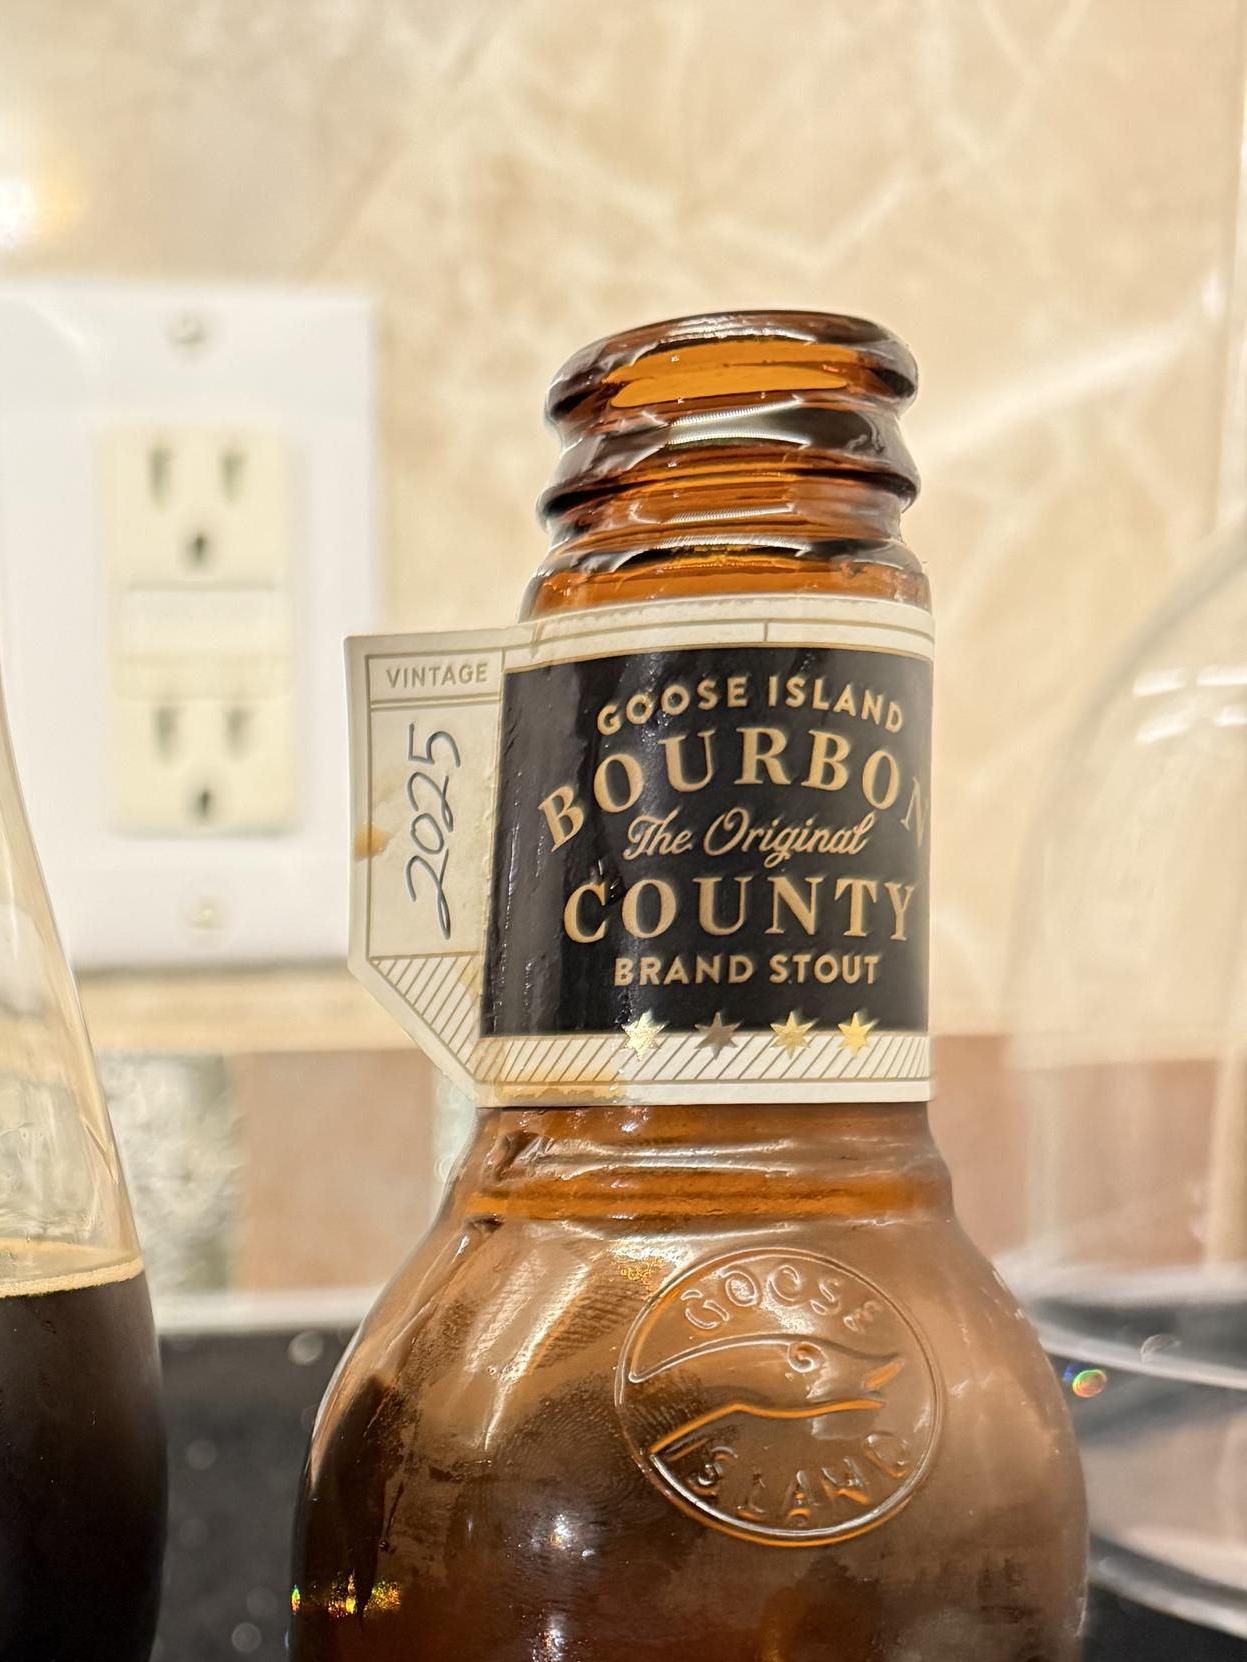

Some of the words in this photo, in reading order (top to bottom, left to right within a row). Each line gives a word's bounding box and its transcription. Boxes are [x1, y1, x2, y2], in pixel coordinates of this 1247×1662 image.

[385, 661, 489, 690] VINTAGE
[597, 676, 748, 737] GOOSE
[767, 674, 905, 735] ISLAND
[537, 725, 930, 853] BOURBON
[404, 722, 462, 941] 2025
[623, 806, 693, 861] The
[702, 807, 875, 868] Original
[562, 876, 916, 944] COUNTY
[613, 955, 755, 988] BRAND
[769, 953, 880, 986] STOUT
[679, 1263, 886, 1337] GOOSE
